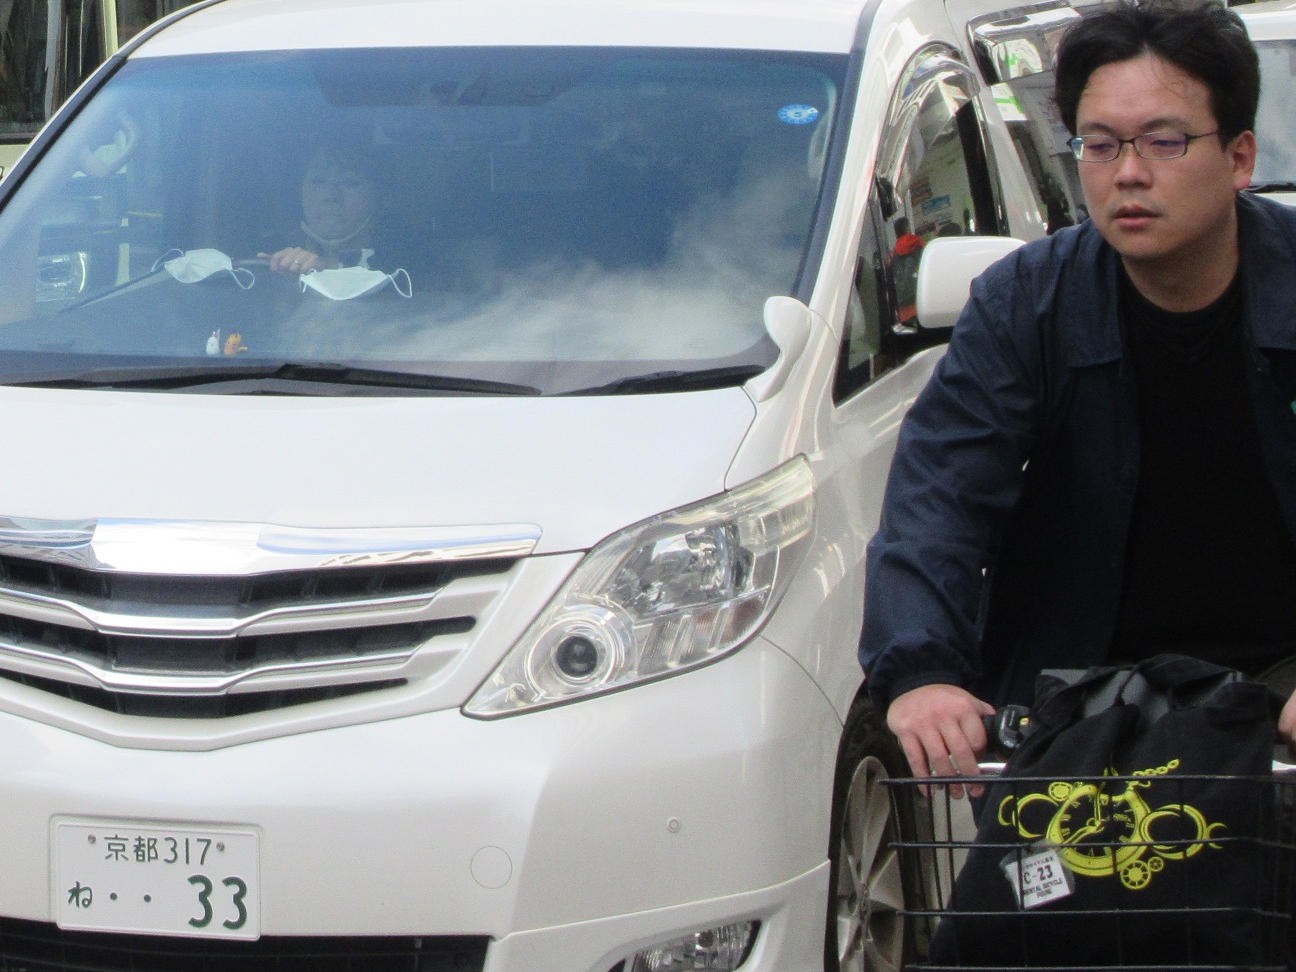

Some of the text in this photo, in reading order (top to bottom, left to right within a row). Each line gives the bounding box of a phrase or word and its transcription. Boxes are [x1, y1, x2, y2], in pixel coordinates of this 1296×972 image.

[104, 834, 212, 865] 京都317
[1023, 864, 1053, 884] C-23
[67, 880, 93, 908] ね
[187, 874, 247, 930] 33
